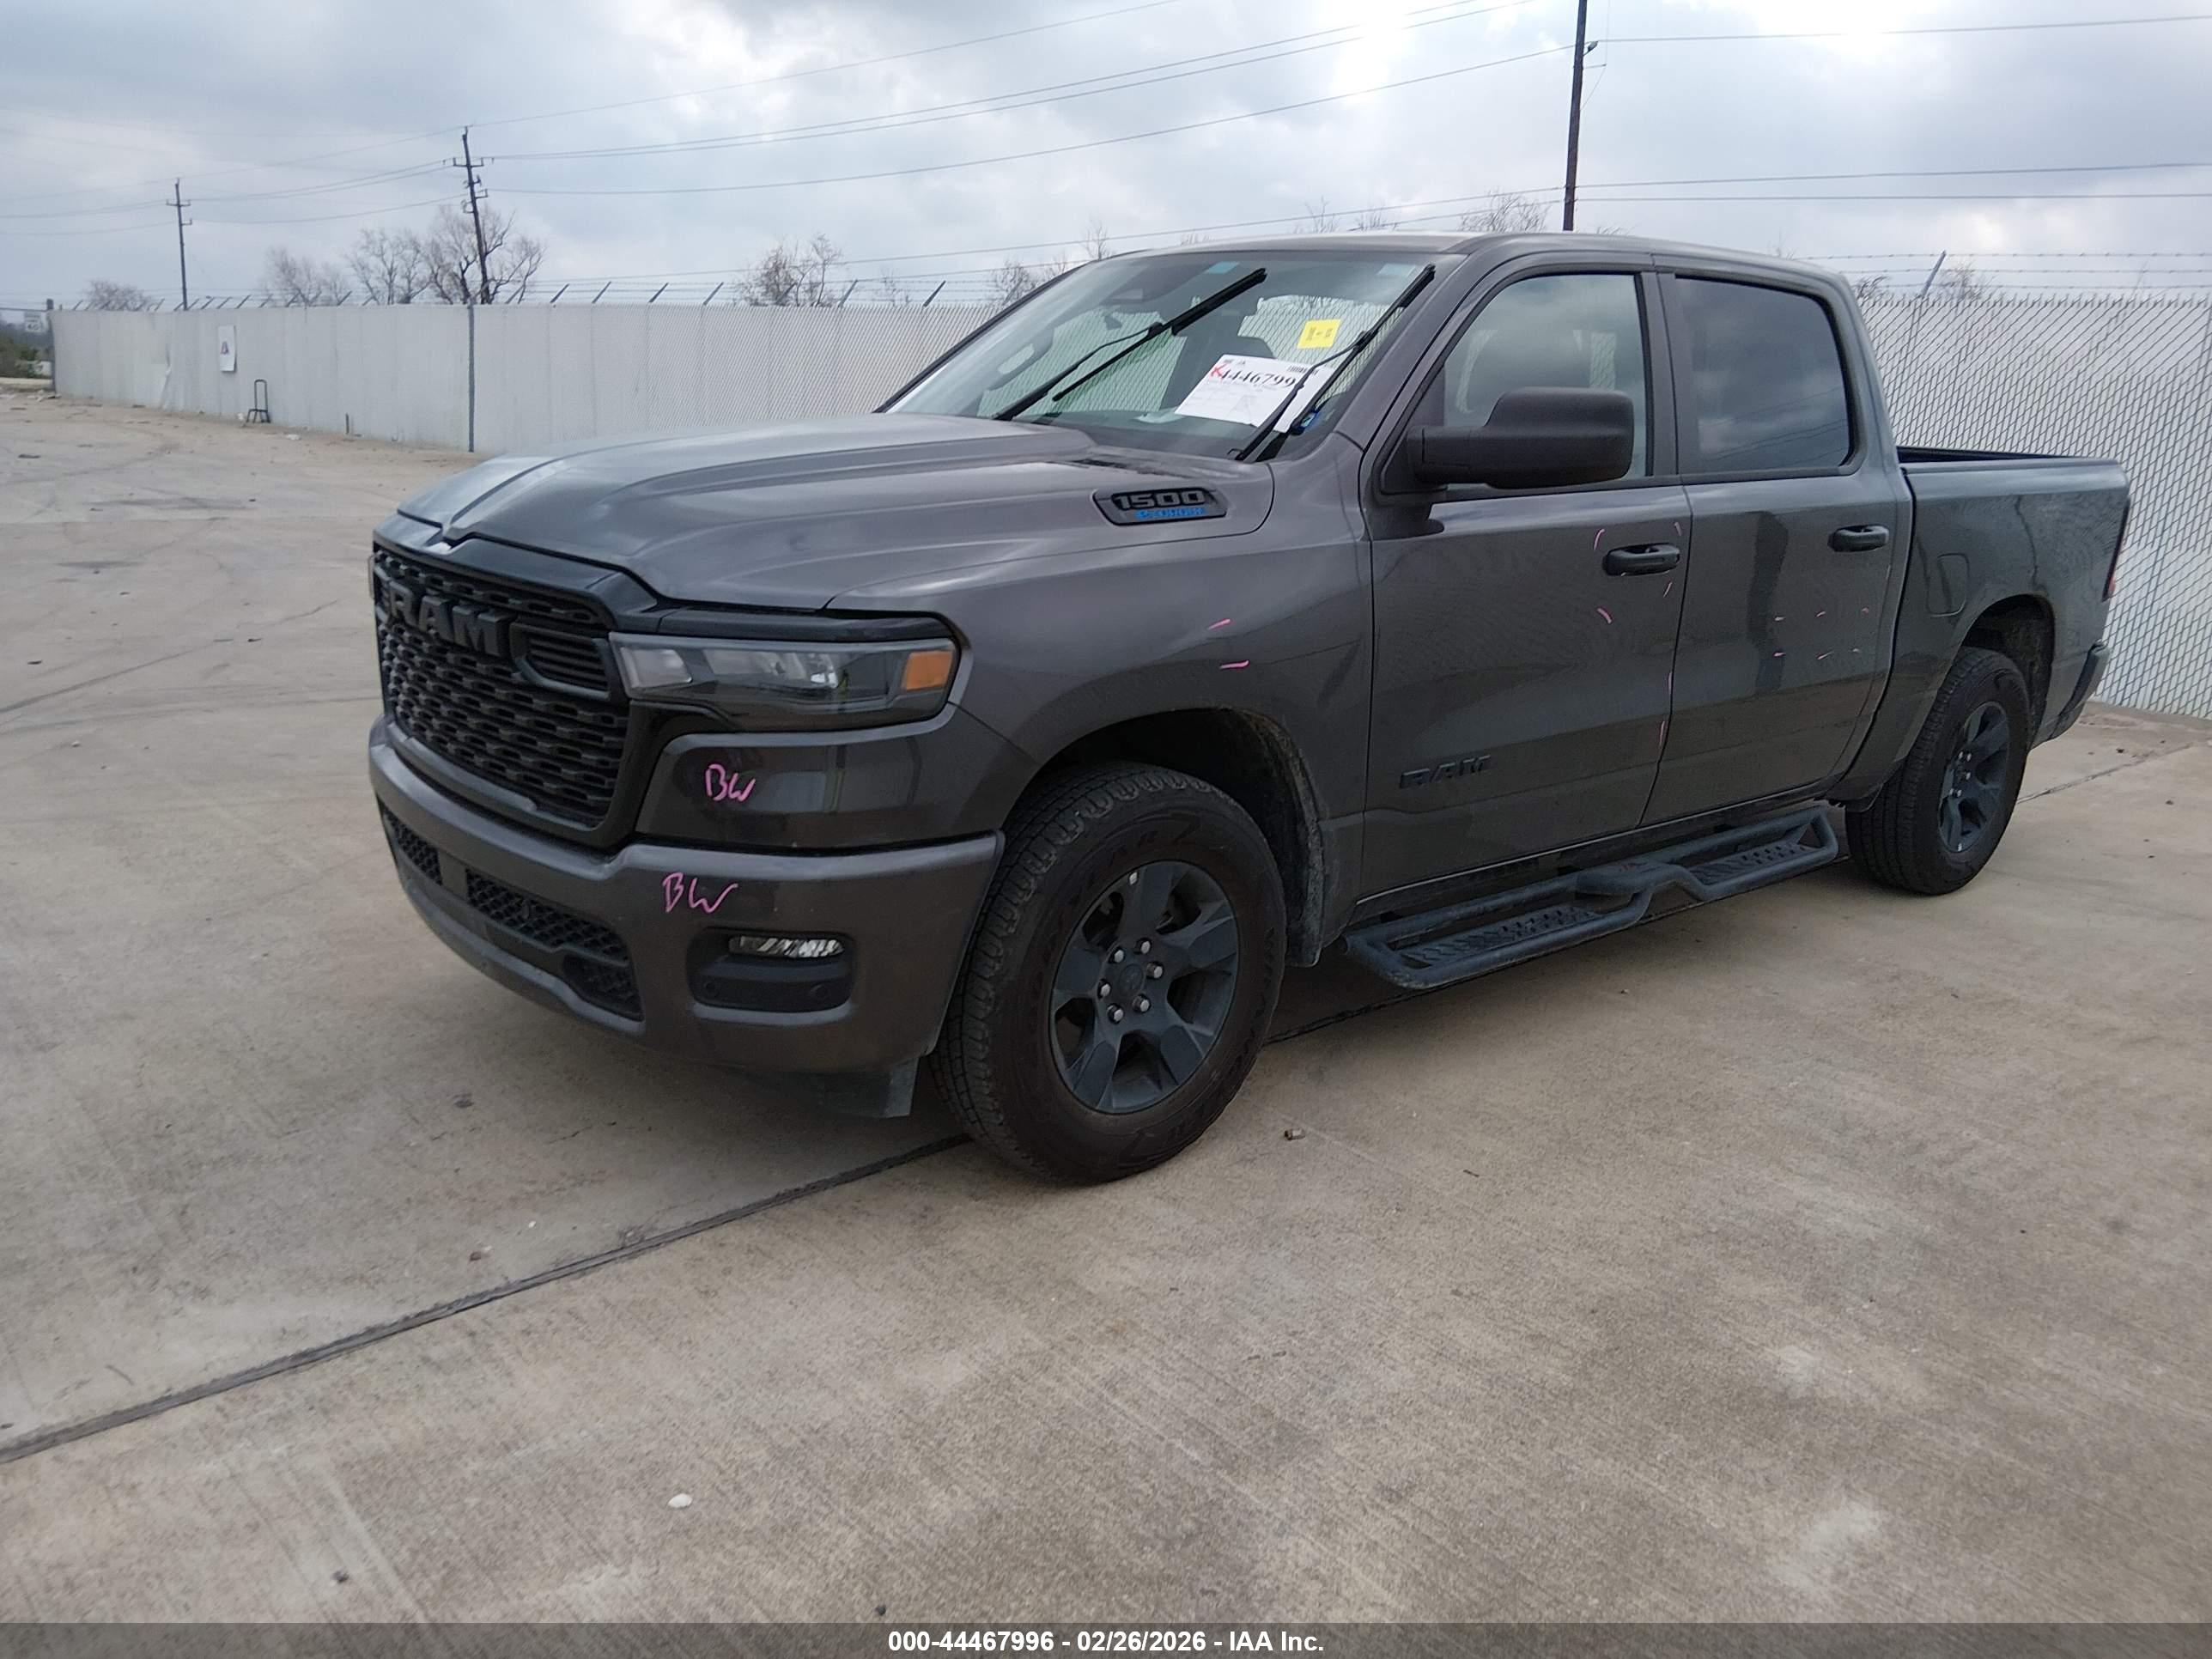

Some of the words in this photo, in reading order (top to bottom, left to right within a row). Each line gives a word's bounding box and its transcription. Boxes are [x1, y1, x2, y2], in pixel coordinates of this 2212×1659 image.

[1222, 369, 1298, 388] 4446799
[1115, 489, 1206, 509] 1500
[388, 580, 507, 659] RAM
[705, 763, 757, 802] BW
[662, 872, 739, 914] BW
